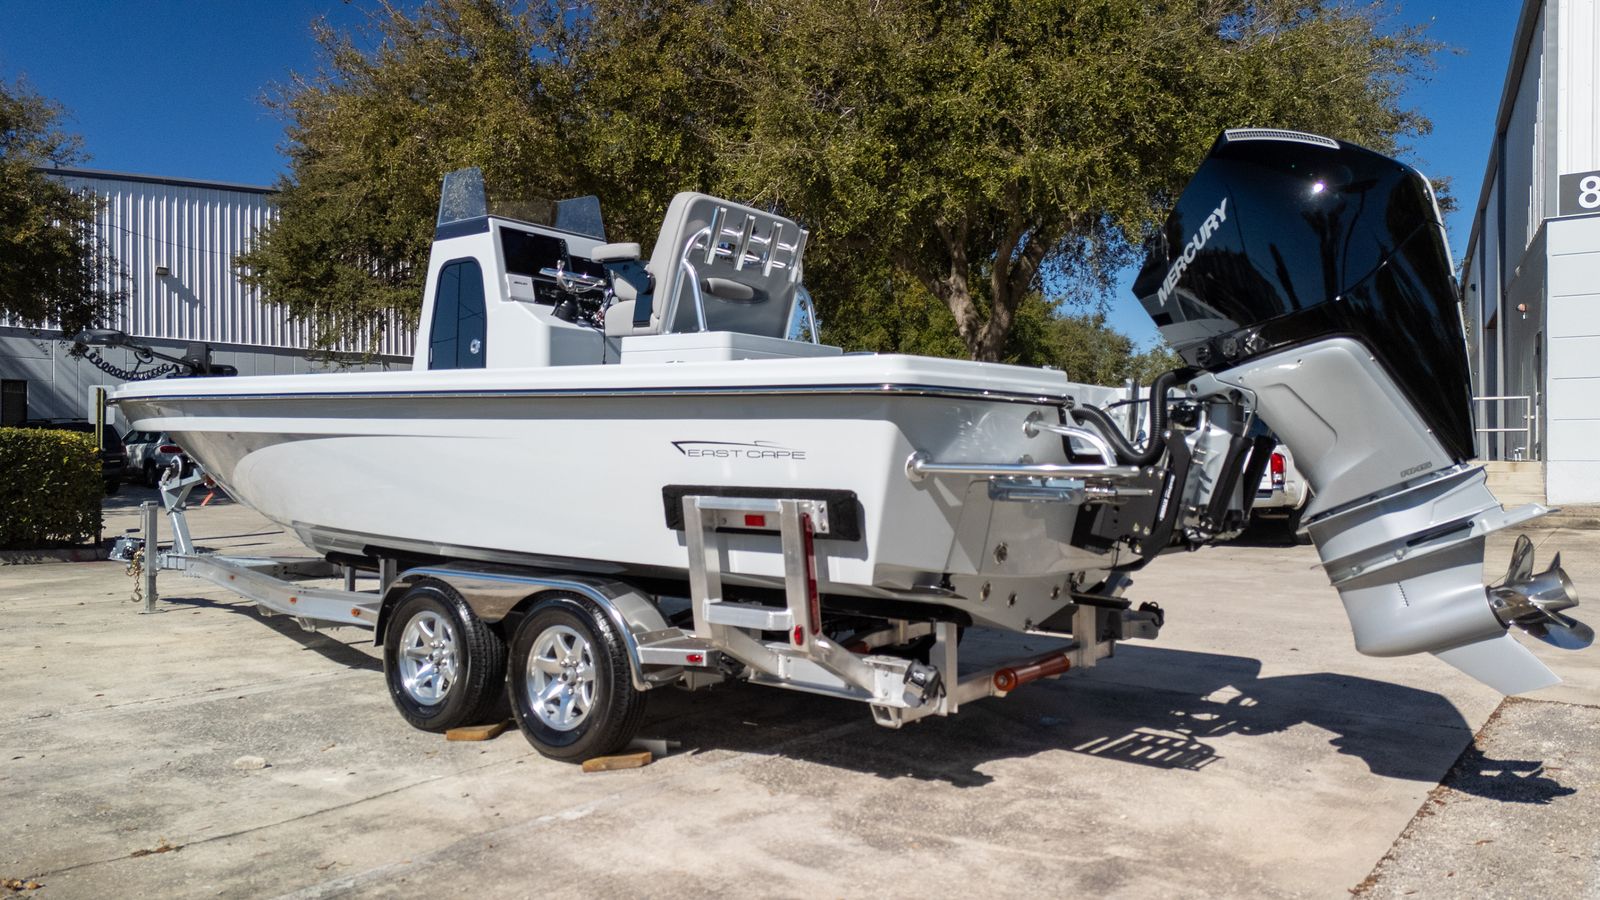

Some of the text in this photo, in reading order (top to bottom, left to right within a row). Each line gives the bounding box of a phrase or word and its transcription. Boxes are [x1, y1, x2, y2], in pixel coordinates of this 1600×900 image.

[1578, 175, 1600, 209] 8
[1157, 197, 1227, 307] MERCURY
[687, 449, 807, 460] EAST CAPE
